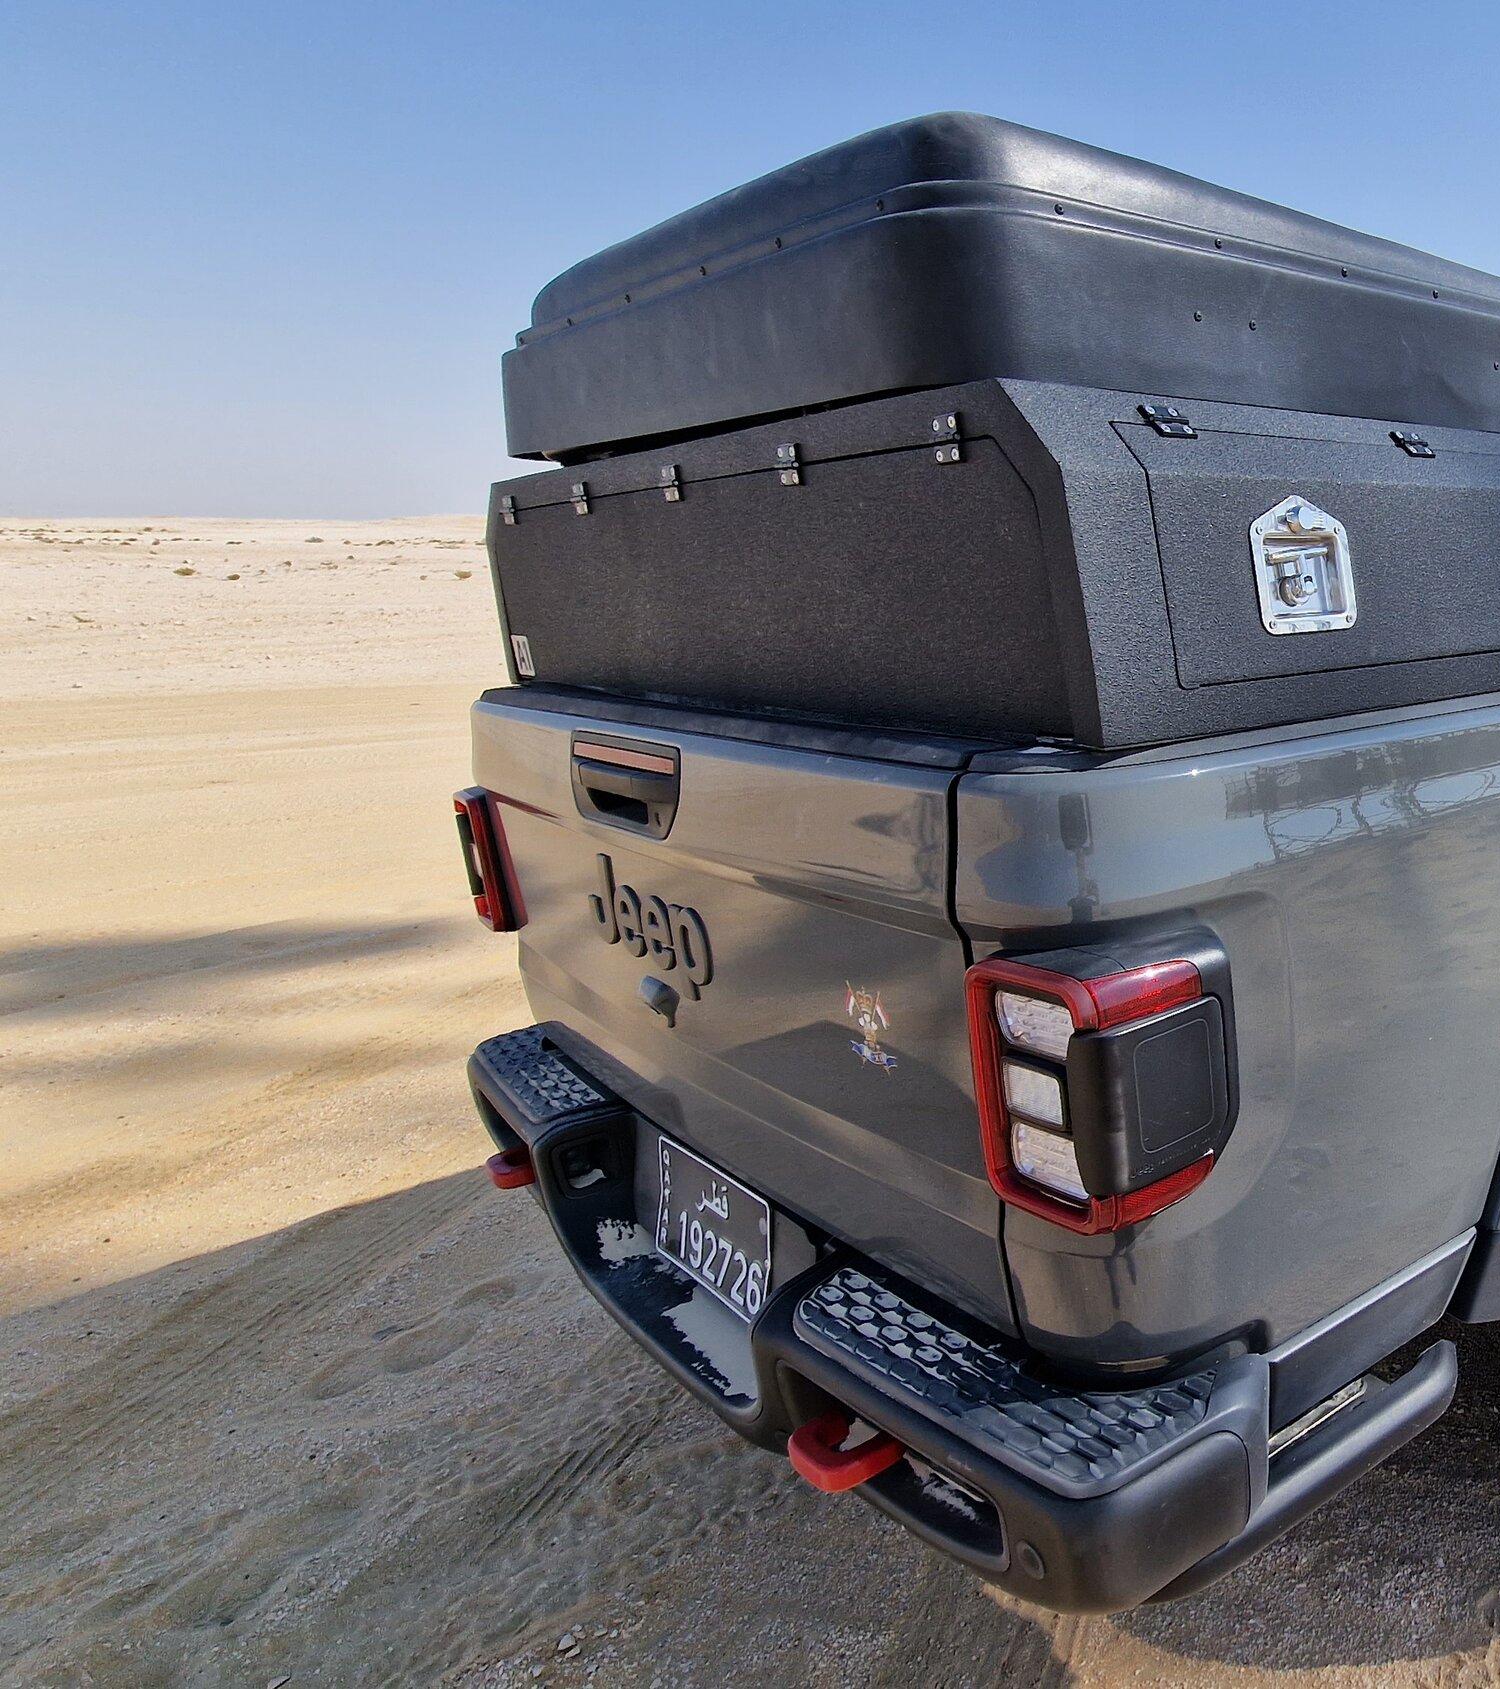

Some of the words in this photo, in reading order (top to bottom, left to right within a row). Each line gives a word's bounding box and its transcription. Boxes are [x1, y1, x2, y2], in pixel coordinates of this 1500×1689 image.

[588, 853, 714, 1001] Jeep
[661, 1149, 671, 1245] QATAR
[695, 1180, 730, 1220] قطر
[679, 1210, 764, 1316] 192726
